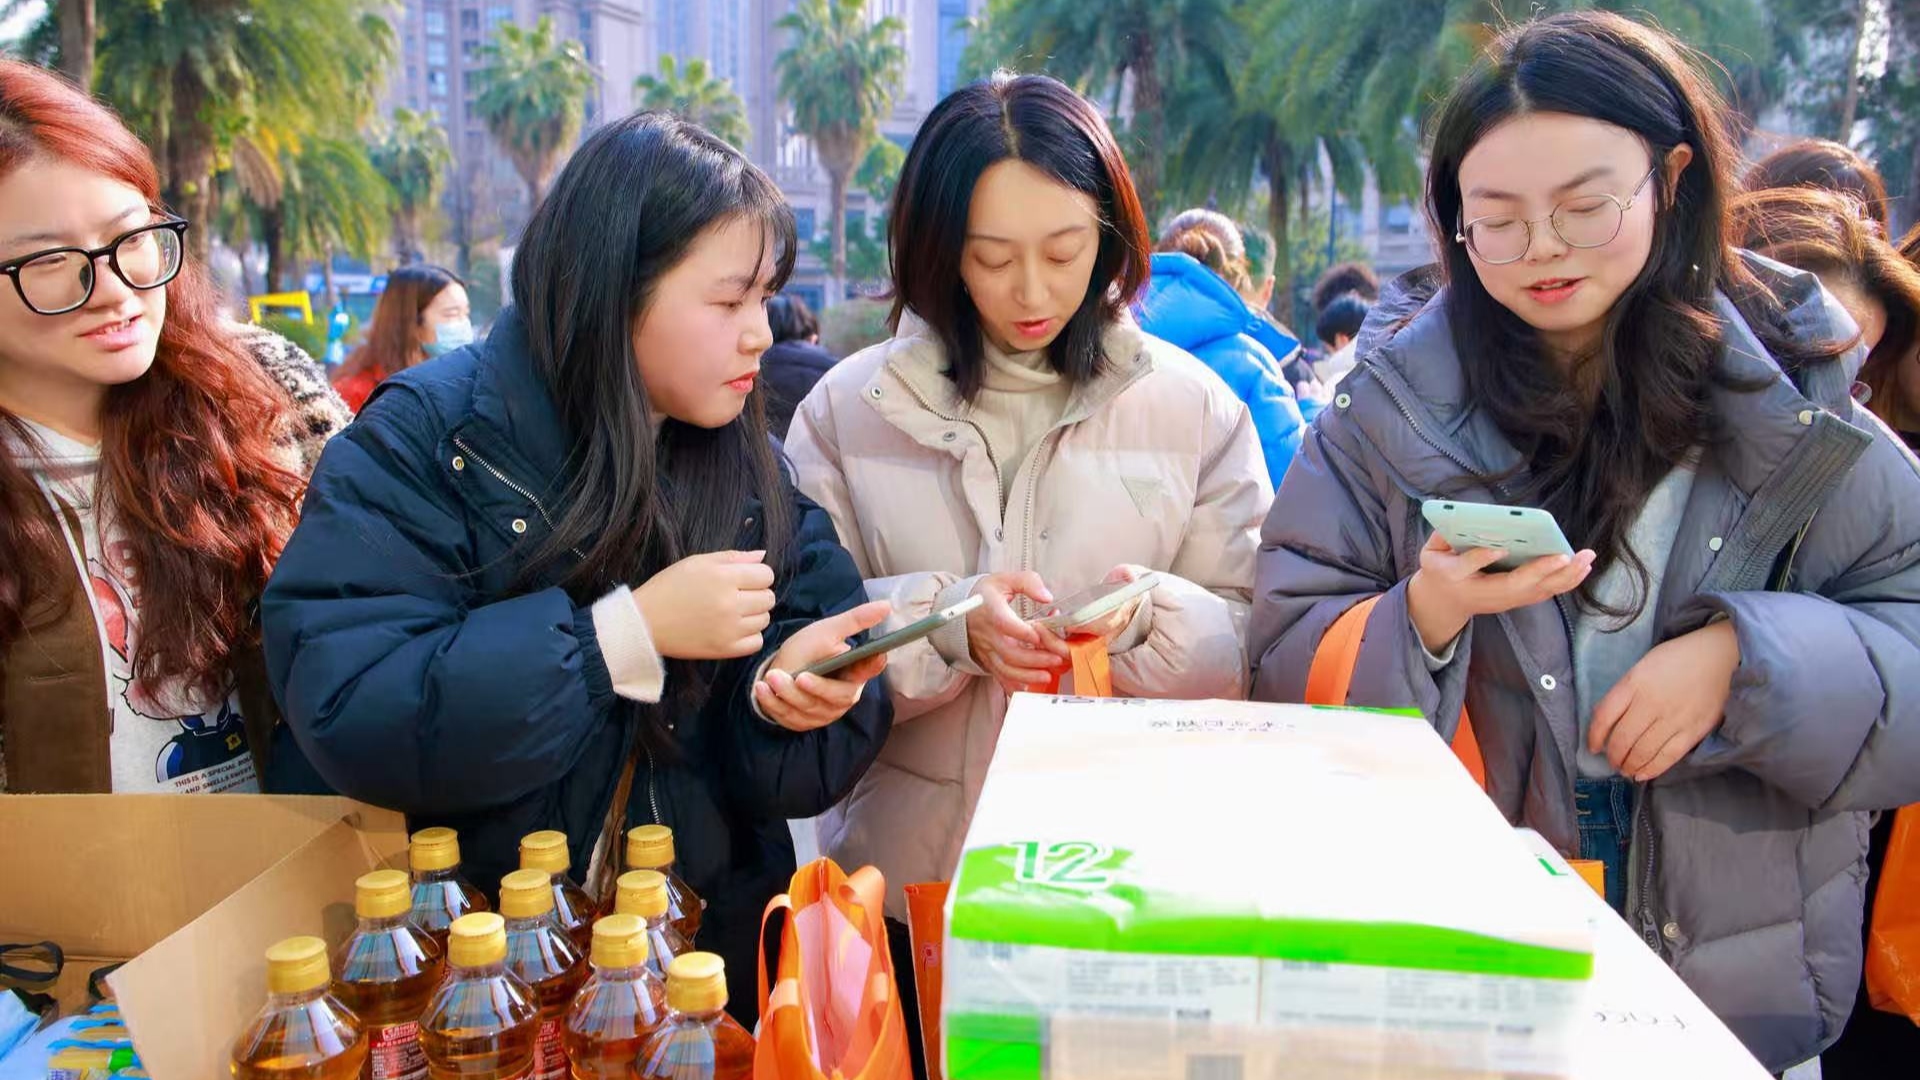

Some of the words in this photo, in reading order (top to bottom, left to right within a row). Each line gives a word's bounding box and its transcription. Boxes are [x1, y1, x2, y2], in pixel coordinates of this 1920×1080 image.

[175, 777, 191, 788] THIS
[192, 775, 199, 783] IS
[201, 772, 208, 780] A
[207, 764, 236, 776] SPECIAL
[185, 786, 200, 794] AND
[202, 775, 229, 790] SMELLS
[1008, 841, 1109, 883] 12
